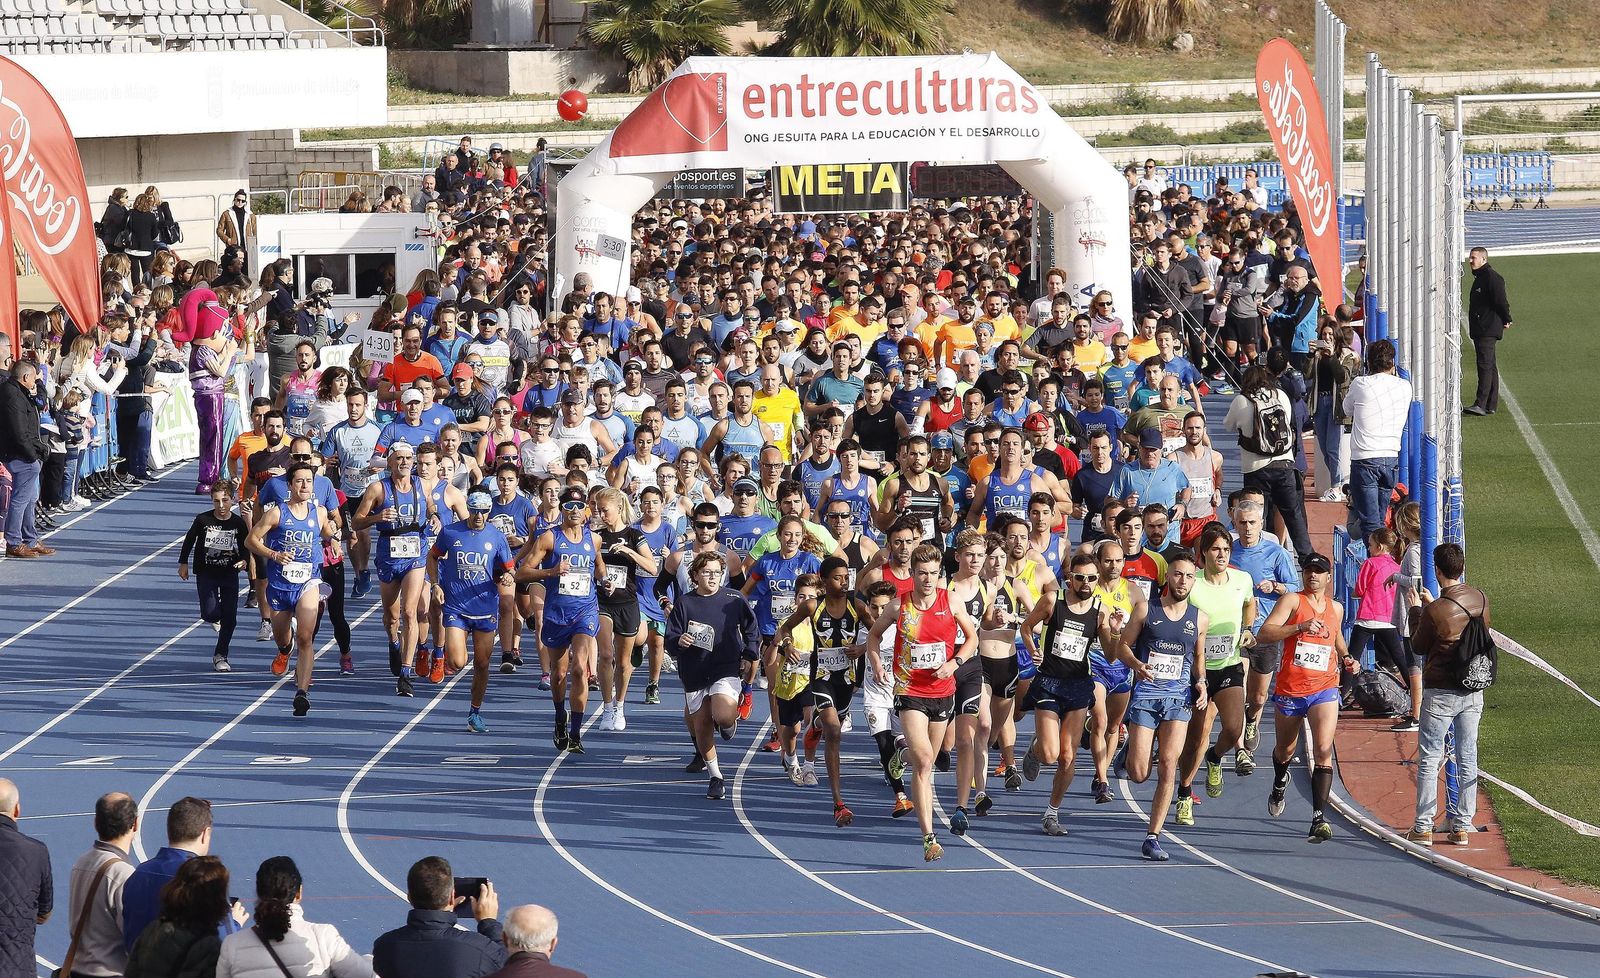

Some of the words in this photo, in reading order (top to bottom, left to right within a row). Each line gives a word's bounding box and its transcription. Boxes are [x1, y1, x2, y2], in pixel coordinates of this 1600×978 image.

[743, 67, 1039, 119] entreculturas
[744, 133, 769, 143] ONG
[772, 132, 817, 143] JESUITA
[820, 130, 848, 141] PARA
[851, 130, 865, 140] LA
[868, 126, 936, 139] EDUCACIÓN
[938, 127, 946, 137] Y
[950, 127, 963, 137] EL
[966, 127, 1040, 138] DESARROLLO
[780, 162, 902, 196] META
[699, 183, 734, 191] deportivos
[603, 238, 622, 252] 5:30
[366, 335, 391, 351] 4:30
[993, 495, 1024, 507] RCM
[211, 536, 229, 546] 4258
[285, 530, 314, 543] RCM
[402, 544, 408, 552] 8
[725, 537, 756, 550] RCM
[456, 551, 488, 566] RCM
[290, 569, 304, 578] 120
[457, 569, 486, 580] 1873
[570, 581, 580, 591] 52
[1060, 642, 1077, 654] 345
[1209, 644, 1226, 654] 420
[824, 656, 845, 665] 4014
[920, 652, 937, 663] 437
[1303, 652, 1321, 664] 282
[1153, 663, 1176, 674] 4230
[1462, 679, 1492, 690] QUEEN
